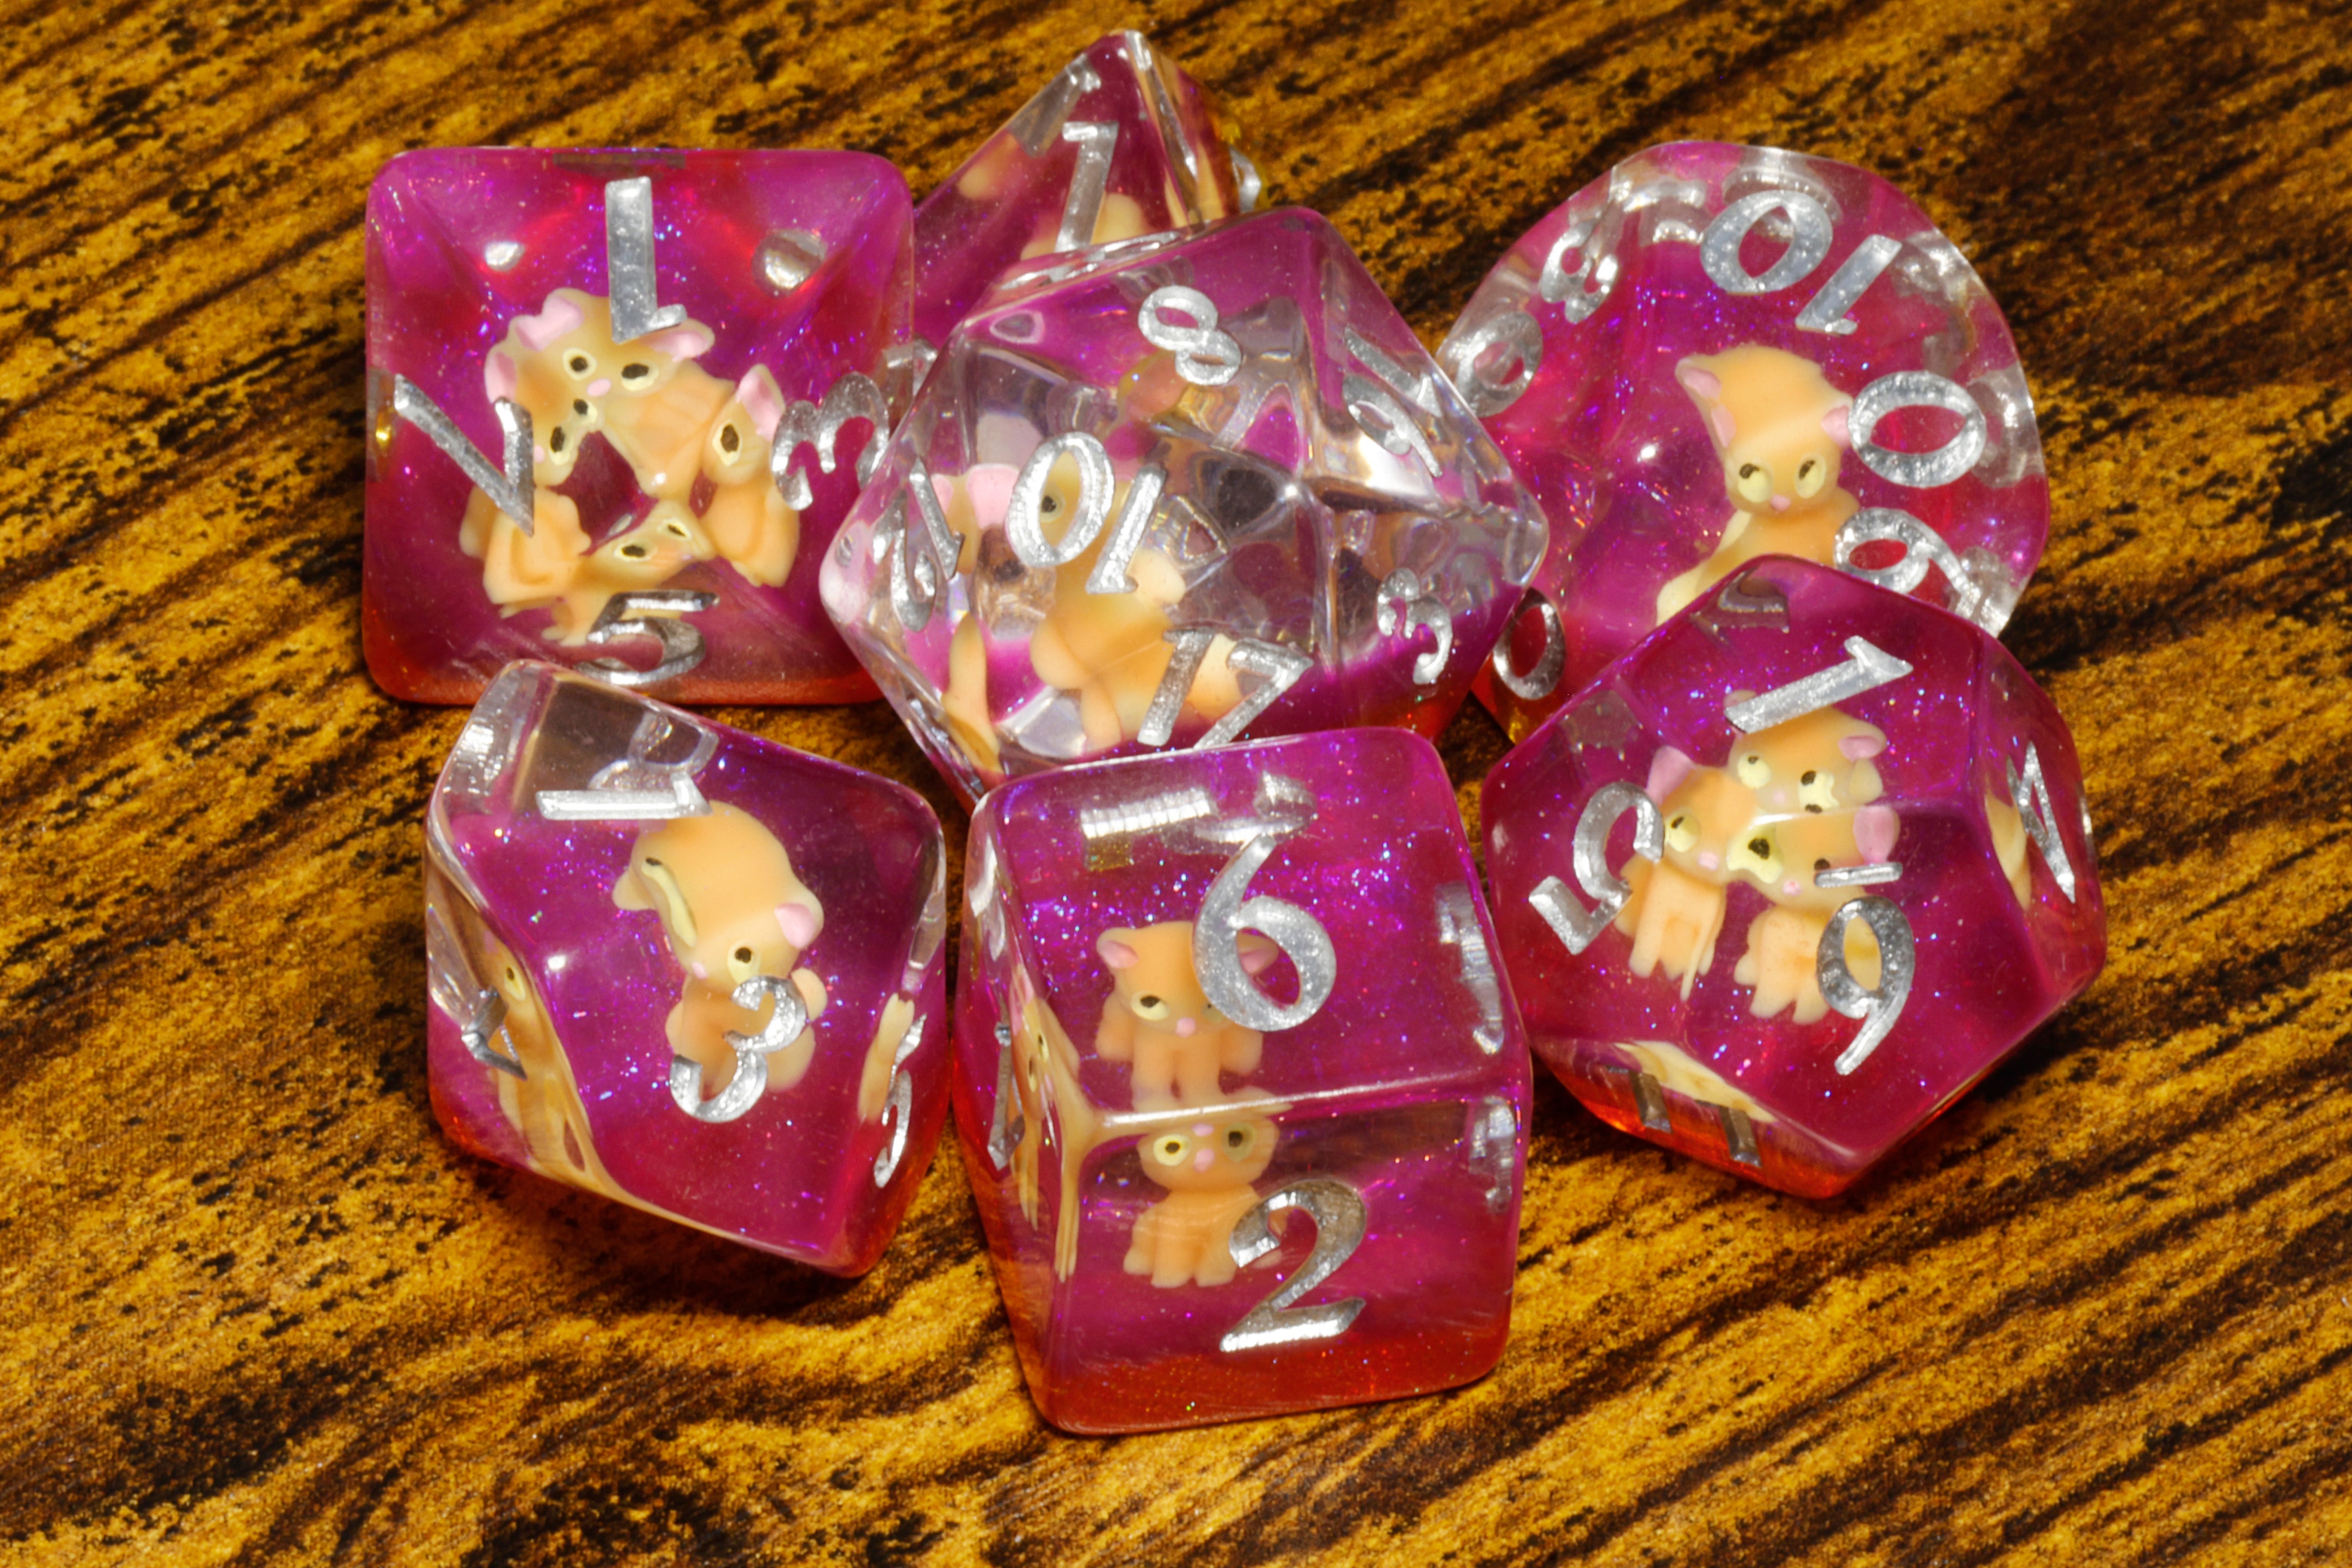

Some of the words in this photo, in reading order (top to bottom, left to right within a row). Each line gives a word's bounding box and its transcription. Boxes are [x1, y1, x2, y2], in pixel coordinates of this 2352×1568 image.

[1054, 121, 1119, 254] 1
[605, 175, 688, 345] 1
[1137, 285, 1243, 385] 8
[393, 372, 535, 537] 7
[572, 589, 720, 686] 5
[1137, 627, 1310, 750] 17
[1376, 567, 1453, 685] 3
[1723, 634, 1914, 734] 1
[536, 771, 713, 820] 1
[1193, 832, 1338, 1032] 6
[1528, 781, 1664, 955] 5
[669, 975, 807, 1124] 3
[1218, 1177, 1367, 1352] 2
